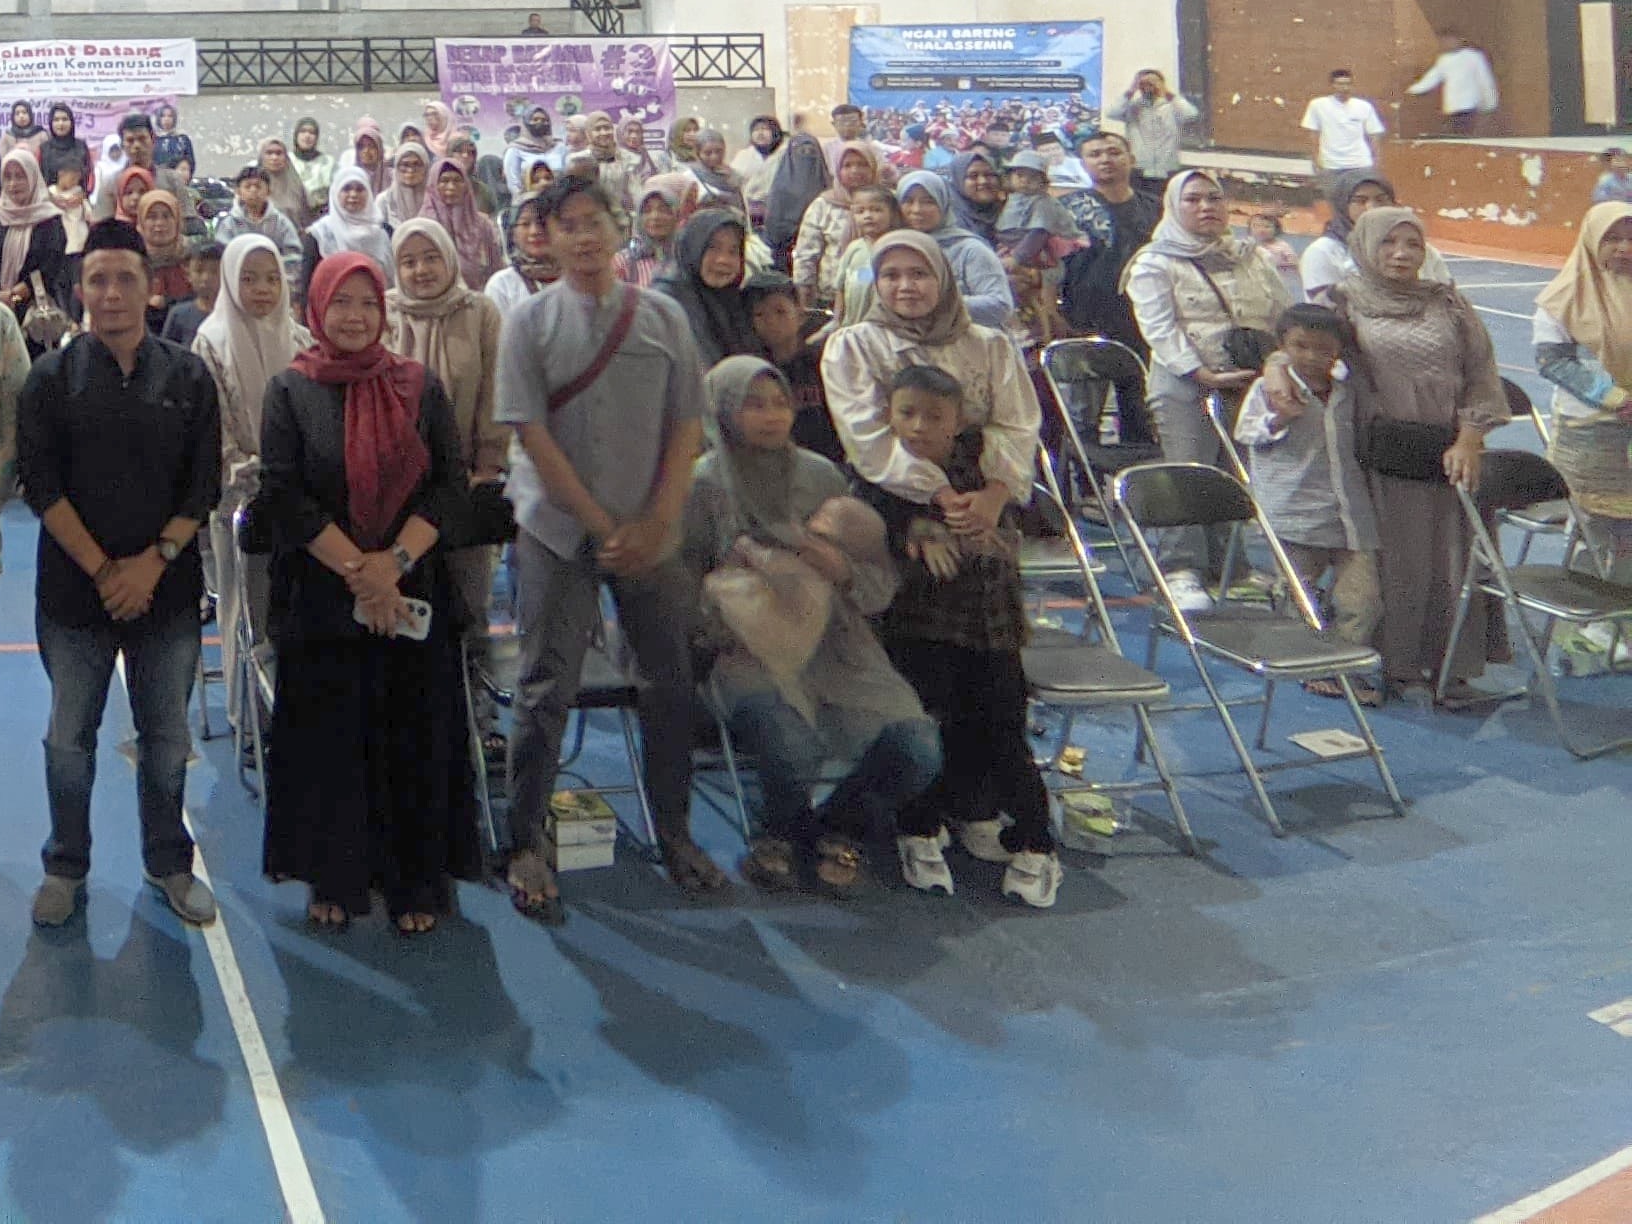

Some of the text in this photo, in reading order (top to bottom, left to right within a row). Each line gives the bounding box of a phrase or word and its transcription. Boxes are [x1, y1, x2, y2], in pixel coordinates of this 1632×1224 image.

[902, 28, 1016, 39] NGAJI BARENG
[904, 39, 1014, 51] THALASSEMIA
[83, 44, 162, 59] Datang
[64, 56, 185, 69] Kemanusiaan
